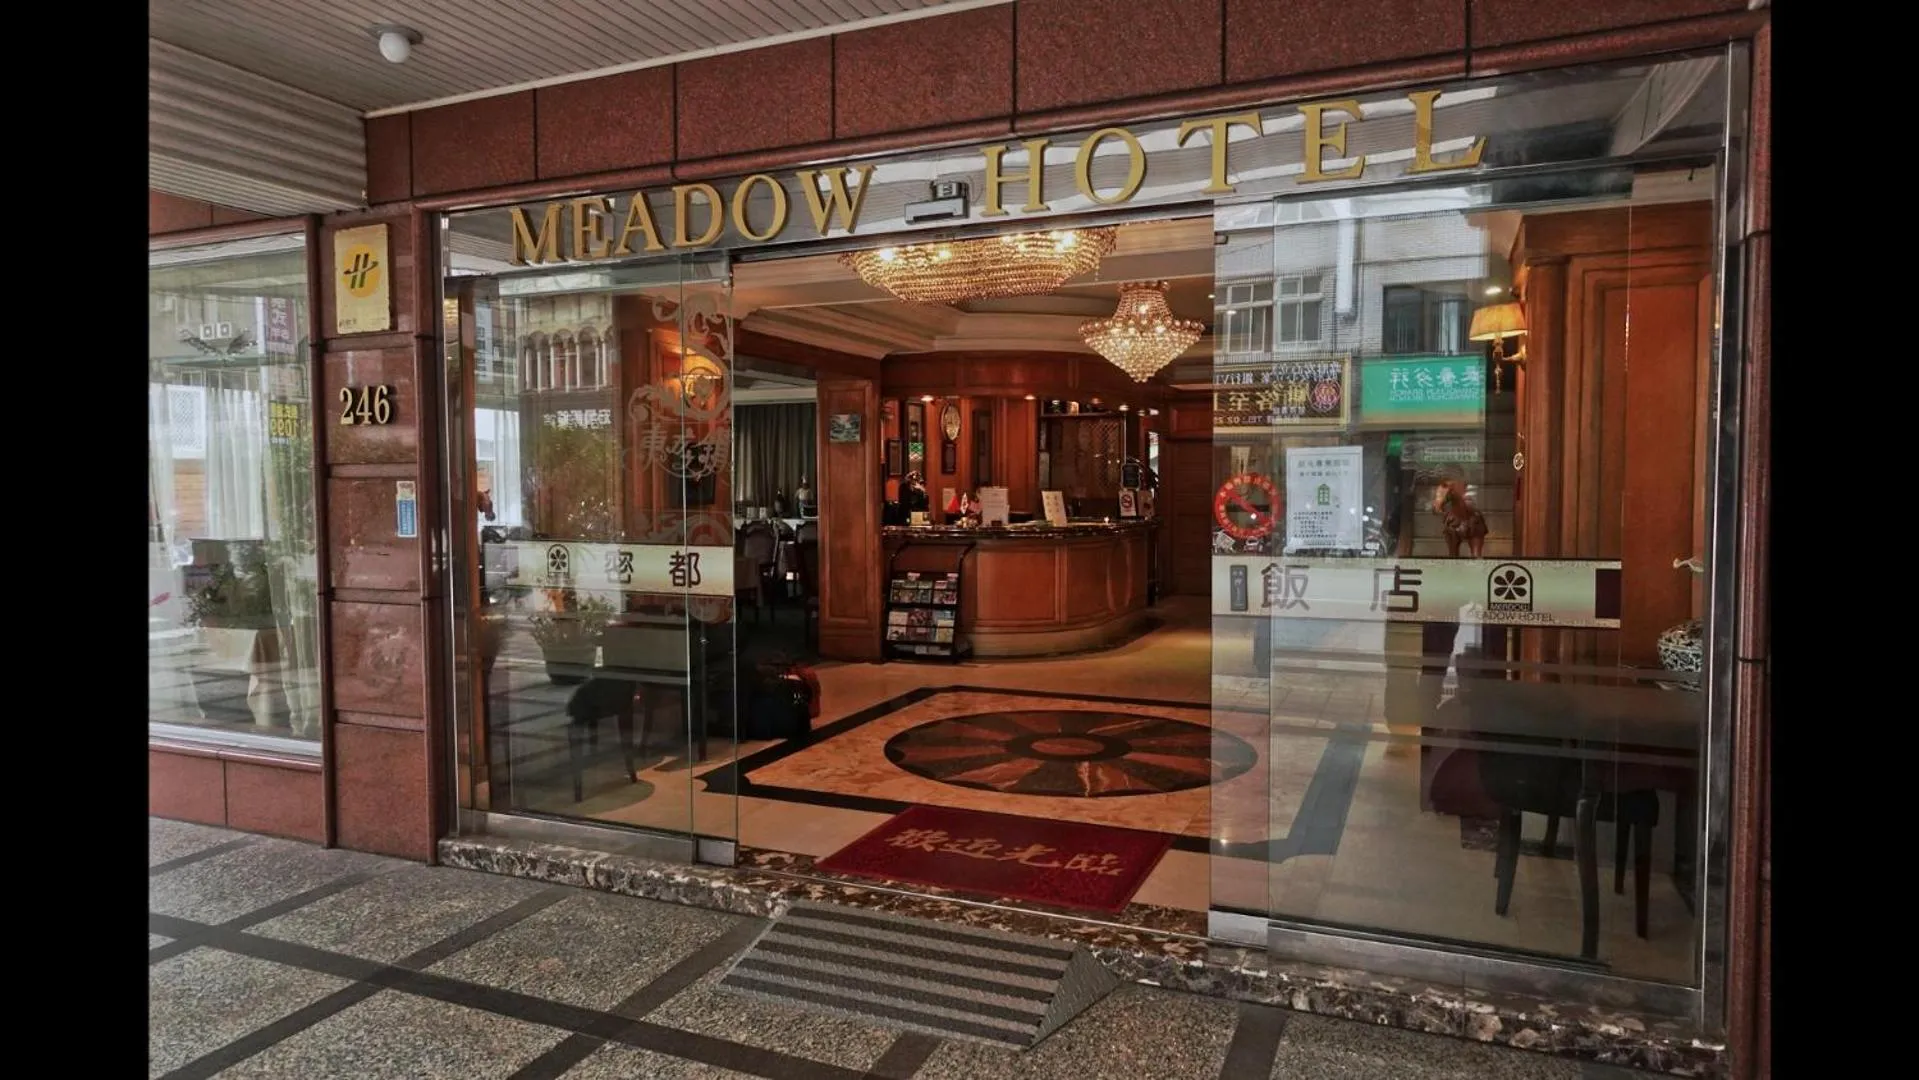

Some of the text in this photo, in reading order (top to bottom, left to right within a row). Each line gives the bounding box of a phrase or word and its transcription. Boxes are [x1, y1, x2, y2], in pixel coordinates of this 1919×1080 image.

[510, 90, 1488, 265] MEADOW HOTEL
[339, 384, 391, 426] 246
[604, 549, 702, 589] 密都
[1260, 562, 1423, 613] 飯店
[1518, 612, 1553, 623] HOTEL
